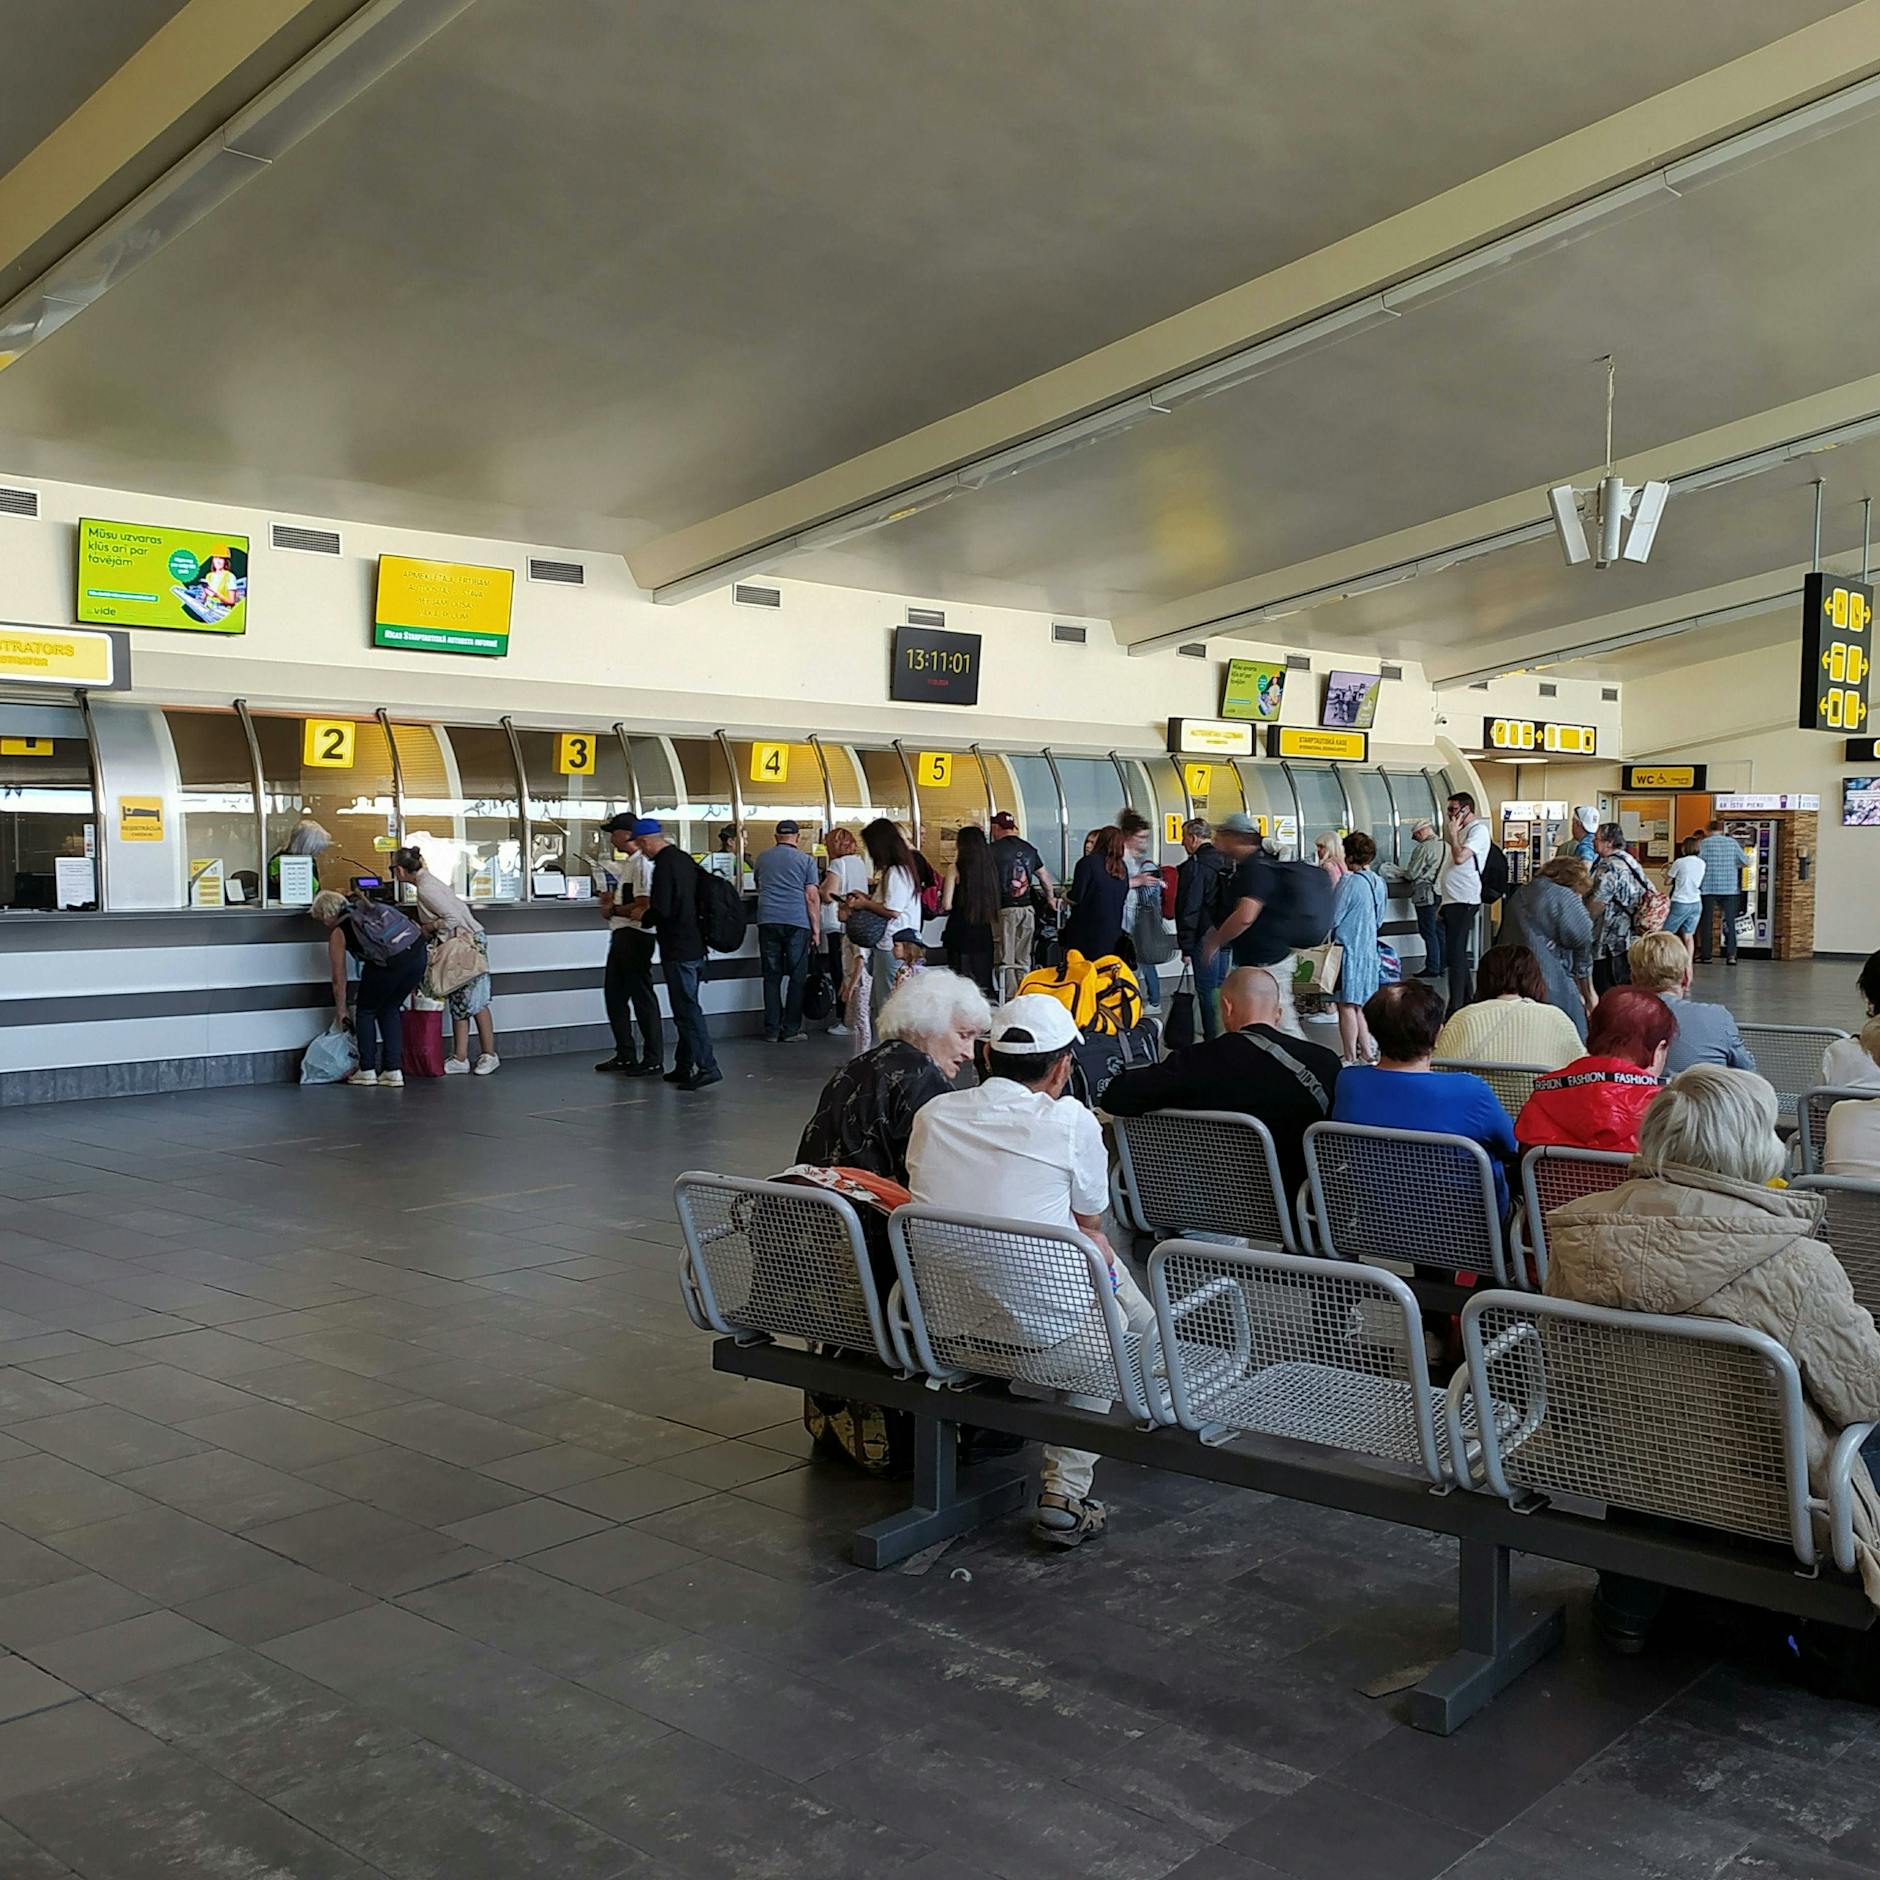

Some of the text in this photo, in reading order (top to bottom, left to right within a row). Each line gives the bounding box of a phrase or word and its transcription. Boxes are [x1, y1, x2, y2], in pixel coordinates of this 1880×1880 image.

[88, 528, 162, 545] Mūsu uzvaras
[130, 547, 149, 556] par
[94, 607, 117, 616] vide
[906, 648, 971, 674] 13:11:01
[321, 728, 344, 760] 2
[568, 738, 587, 768] 3
[765, 750, 780, 775] 4
[932, 757, 945, 780] 5
[1197, 770, 1206, 790] 7
[1636, 775, 1655, 785] WC
[1567, 1071, 1606, 1086] FASHION
[1614, 1072, 1658, 1086] FASHION
